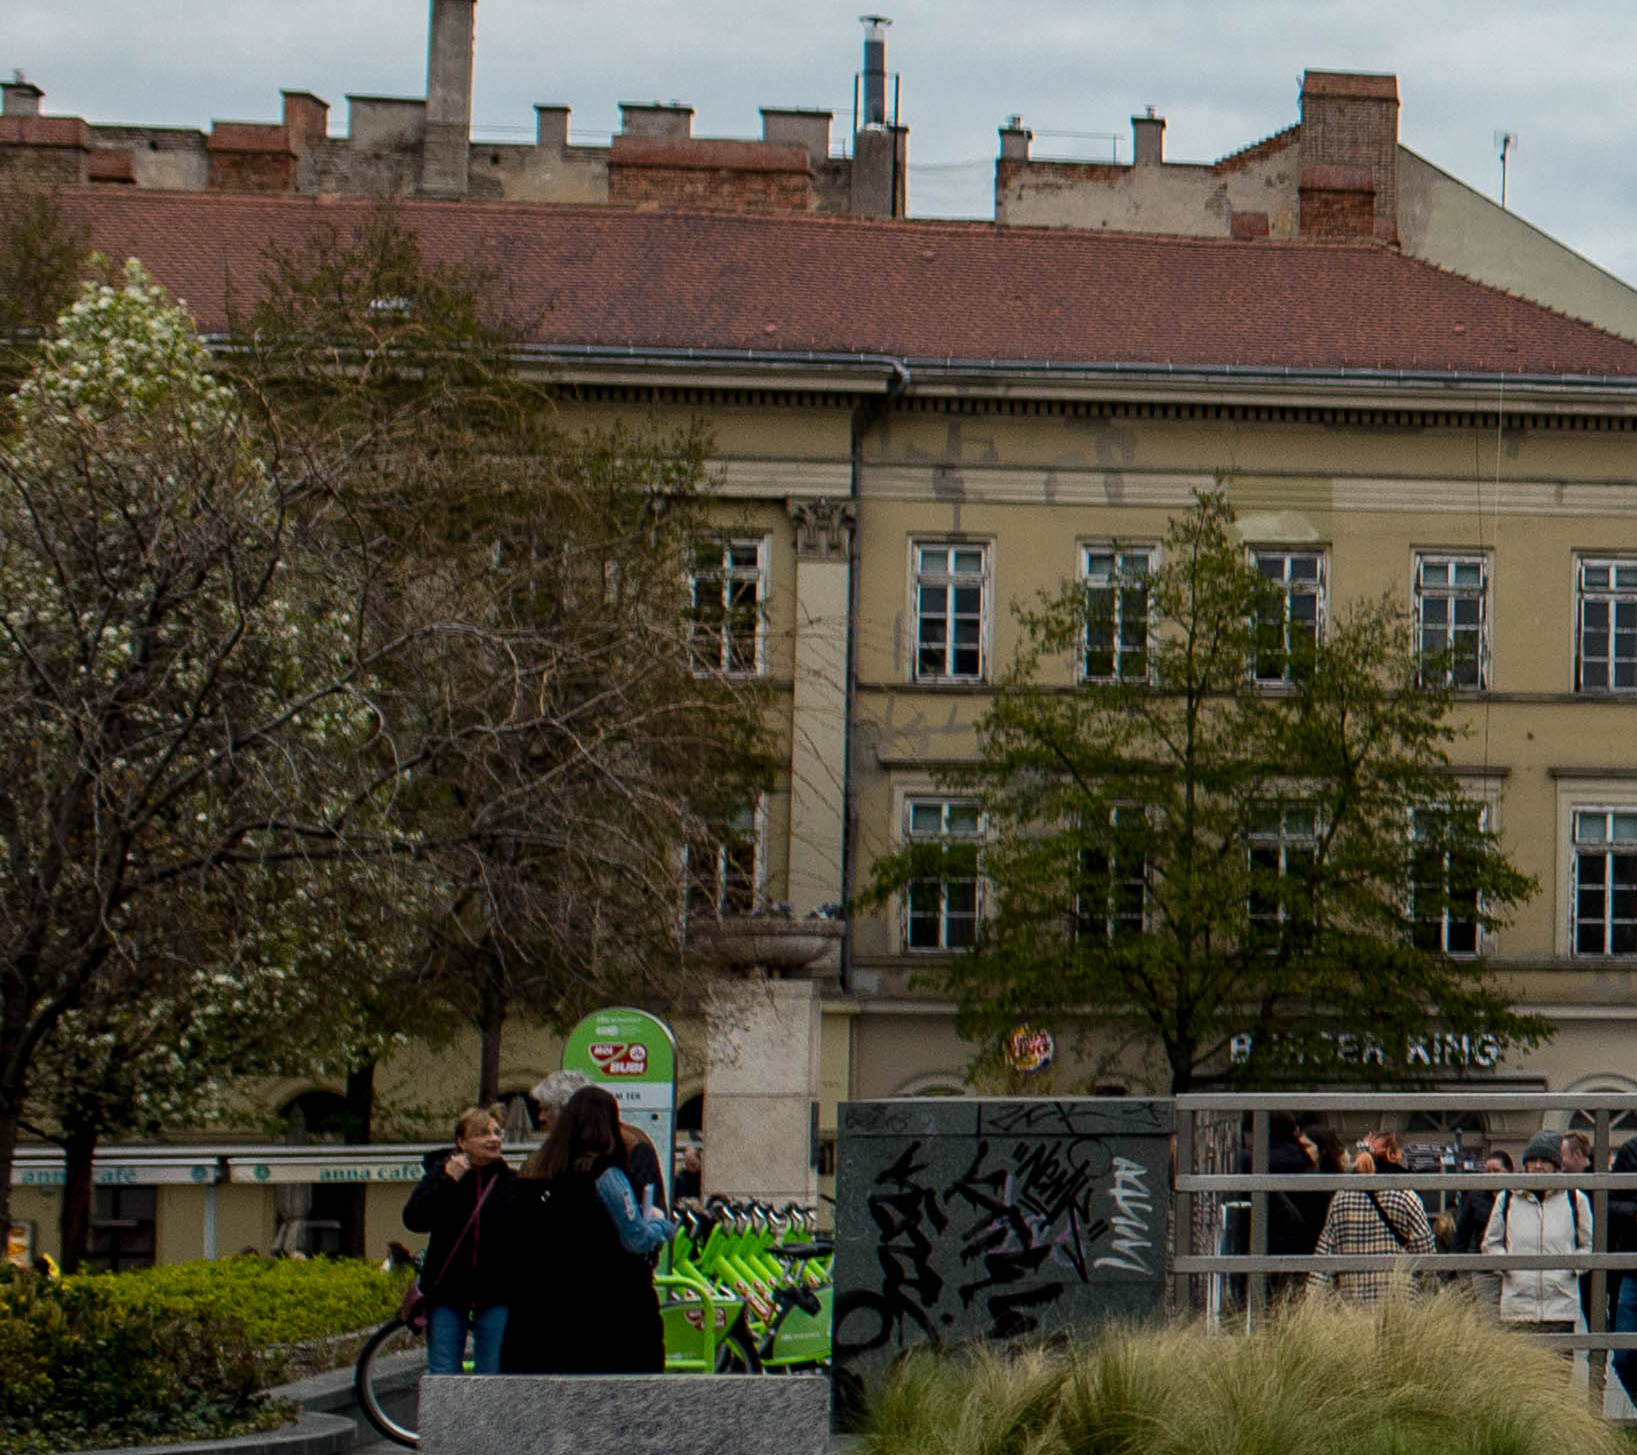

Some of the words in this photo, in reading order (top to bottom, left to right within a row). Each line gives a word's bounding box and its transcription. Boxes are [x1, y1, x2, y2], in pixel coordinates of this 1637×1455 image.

[1406, 1032, 1502, 1066] KING
[21, 1169, 66, 1183] ann
[319, 1165, 371, 1182] anna
[376, 1163, 424, 1180] café
